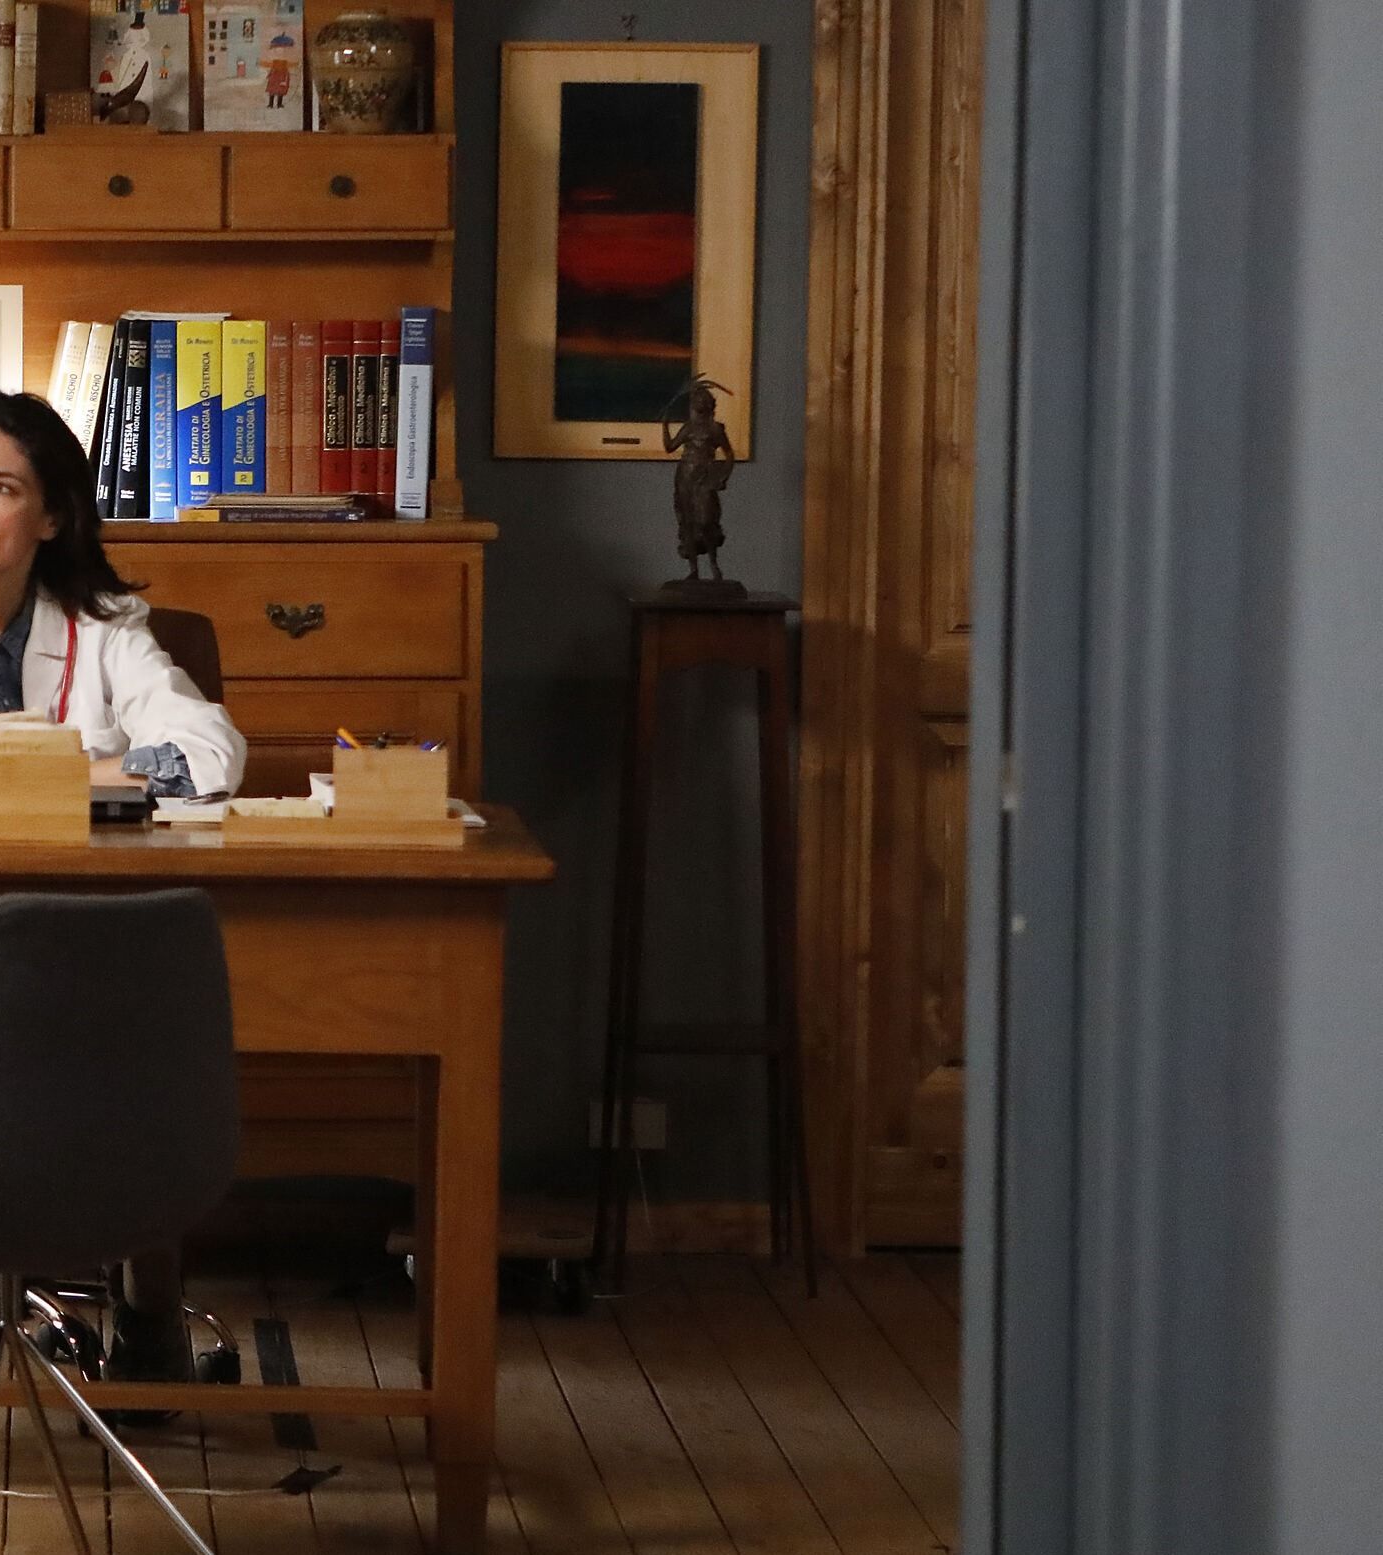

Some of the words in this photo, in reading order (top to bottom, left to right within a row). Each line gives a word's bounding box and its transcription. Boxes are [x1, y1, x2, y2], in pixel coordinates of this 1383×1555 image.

[65, 373, 78, 401] RISCHIO
[134, 386, 142, 415] COMUNI
[327, 366, 336, 407] Medicina
[356, 366, 365, 407] Medicina
[381, 367, 389, 407] Medicina
[80, 409, 95, 452] RAVIDANZA
[89, 374, 102, 402] RISCHIO
[154, 373, 166, 469] ECOGRAFIA
[192, 416, 199, 424] DI
[236, 415, 244, 424] DI
[408, 375, 418, 439] Gastroenterologica
[121, 423, 133, 472] ANESTESIA
[189, 427, 199, 465] TRATTATO
[199, 409, 210, 465] GINECOLOGIA
[234, 426, 244, 465] TRATTATO
[243, 409, 255, 464] GINECOLOGIA
[327, 414, 336, 445] Clinica
[355, 413, 364, 444] Clinica
[380, 414, 388, 444] Clinica
[131, 433, 139, 466] MALATTIE
[407, 440, 416, 479] Endoscopia
[240, 474, 247, 482] 2
